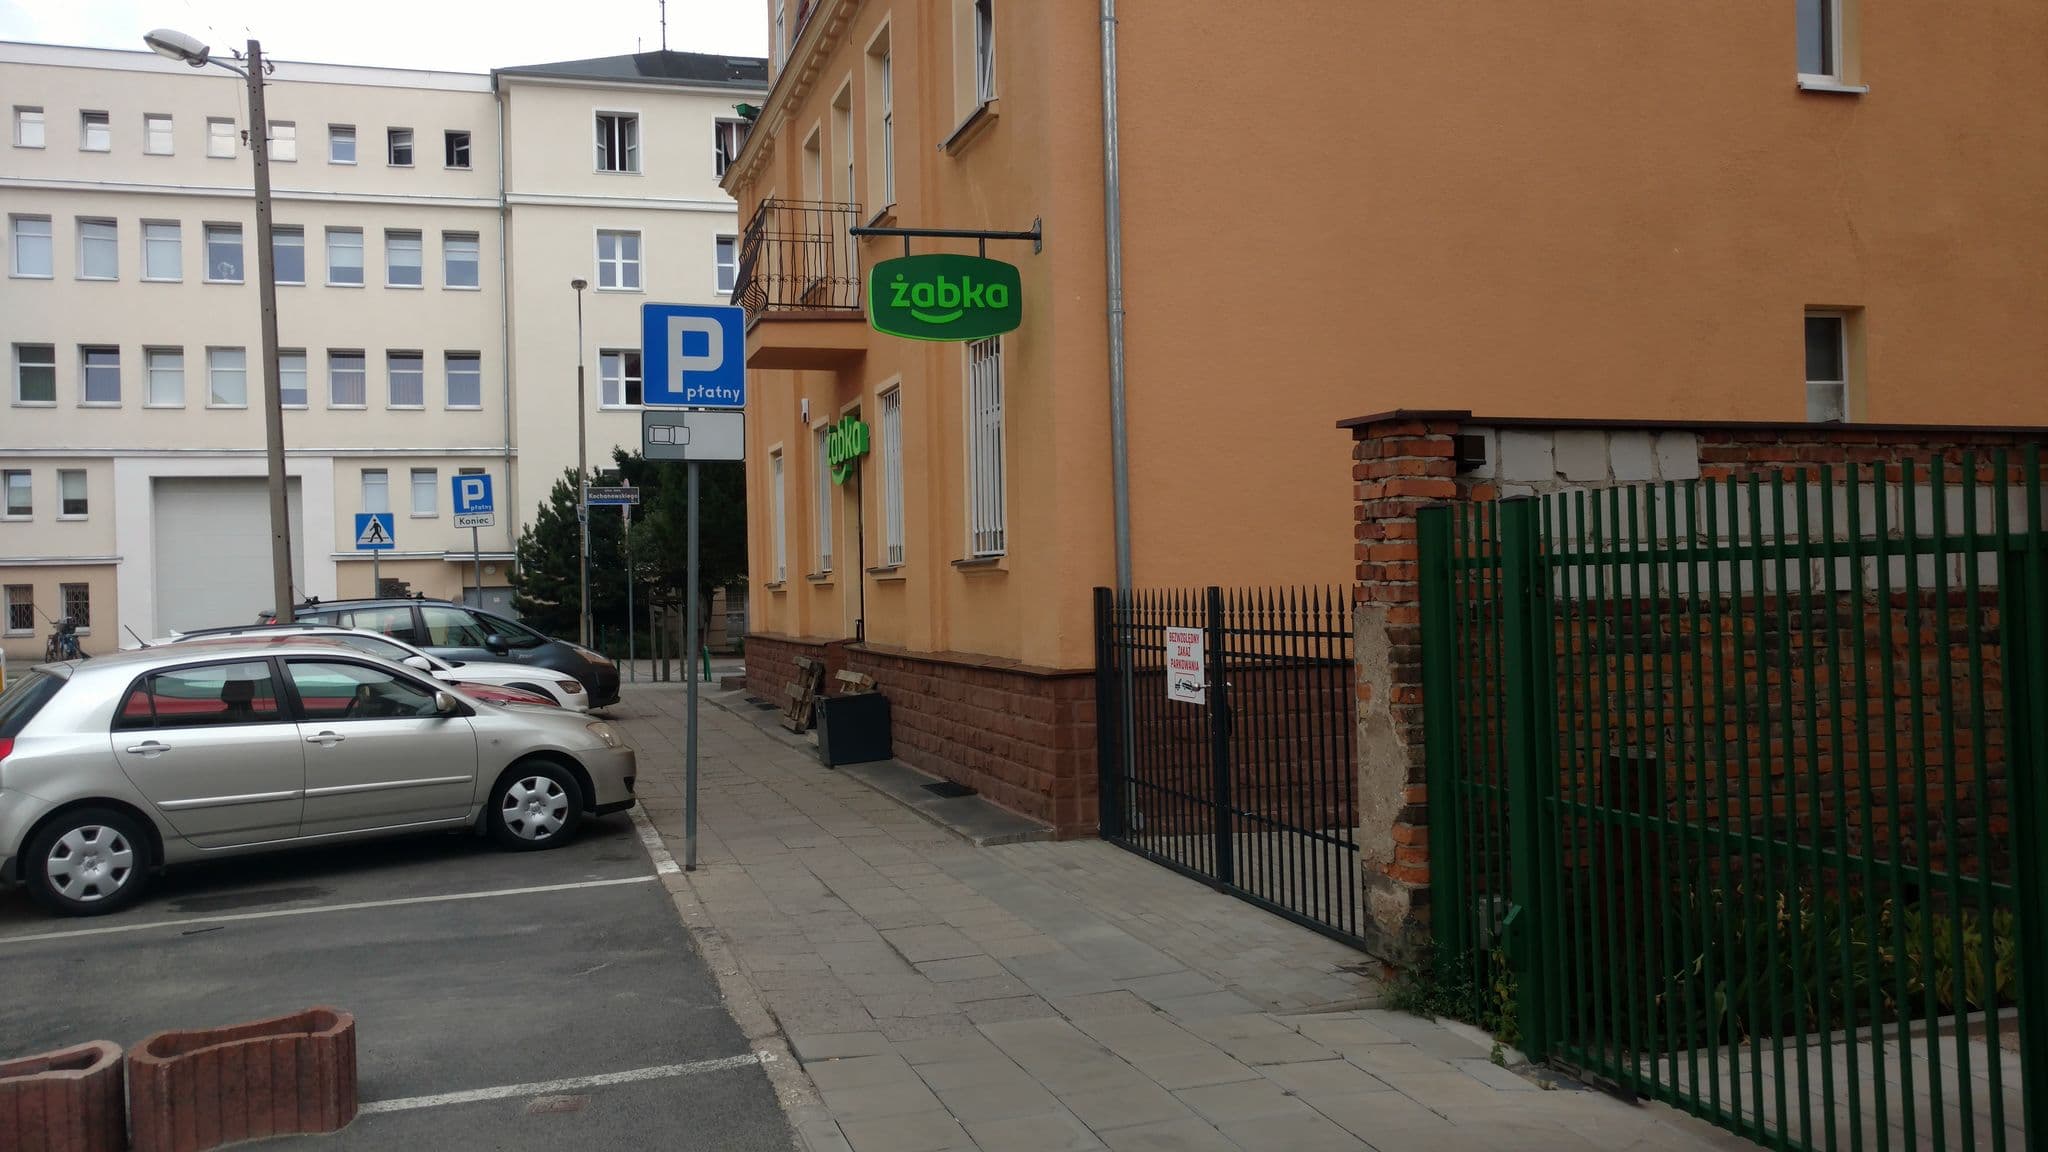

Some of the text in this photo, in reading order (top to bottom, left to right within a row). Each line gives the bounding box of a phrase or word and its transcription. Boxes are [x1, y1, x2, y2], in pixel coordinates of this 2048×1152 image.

[890, 273, 1009, 308] żabka
[667, 315, 724, 393] P
[687, 384, 740, 402] płatny
[461, 479, 485, 509] P
[459, 516, 489, 525] Koniec
[1177, 645, 1191, 656] ZAKAZ
[1170, 658, 1199, 671] PARKOWANIA
